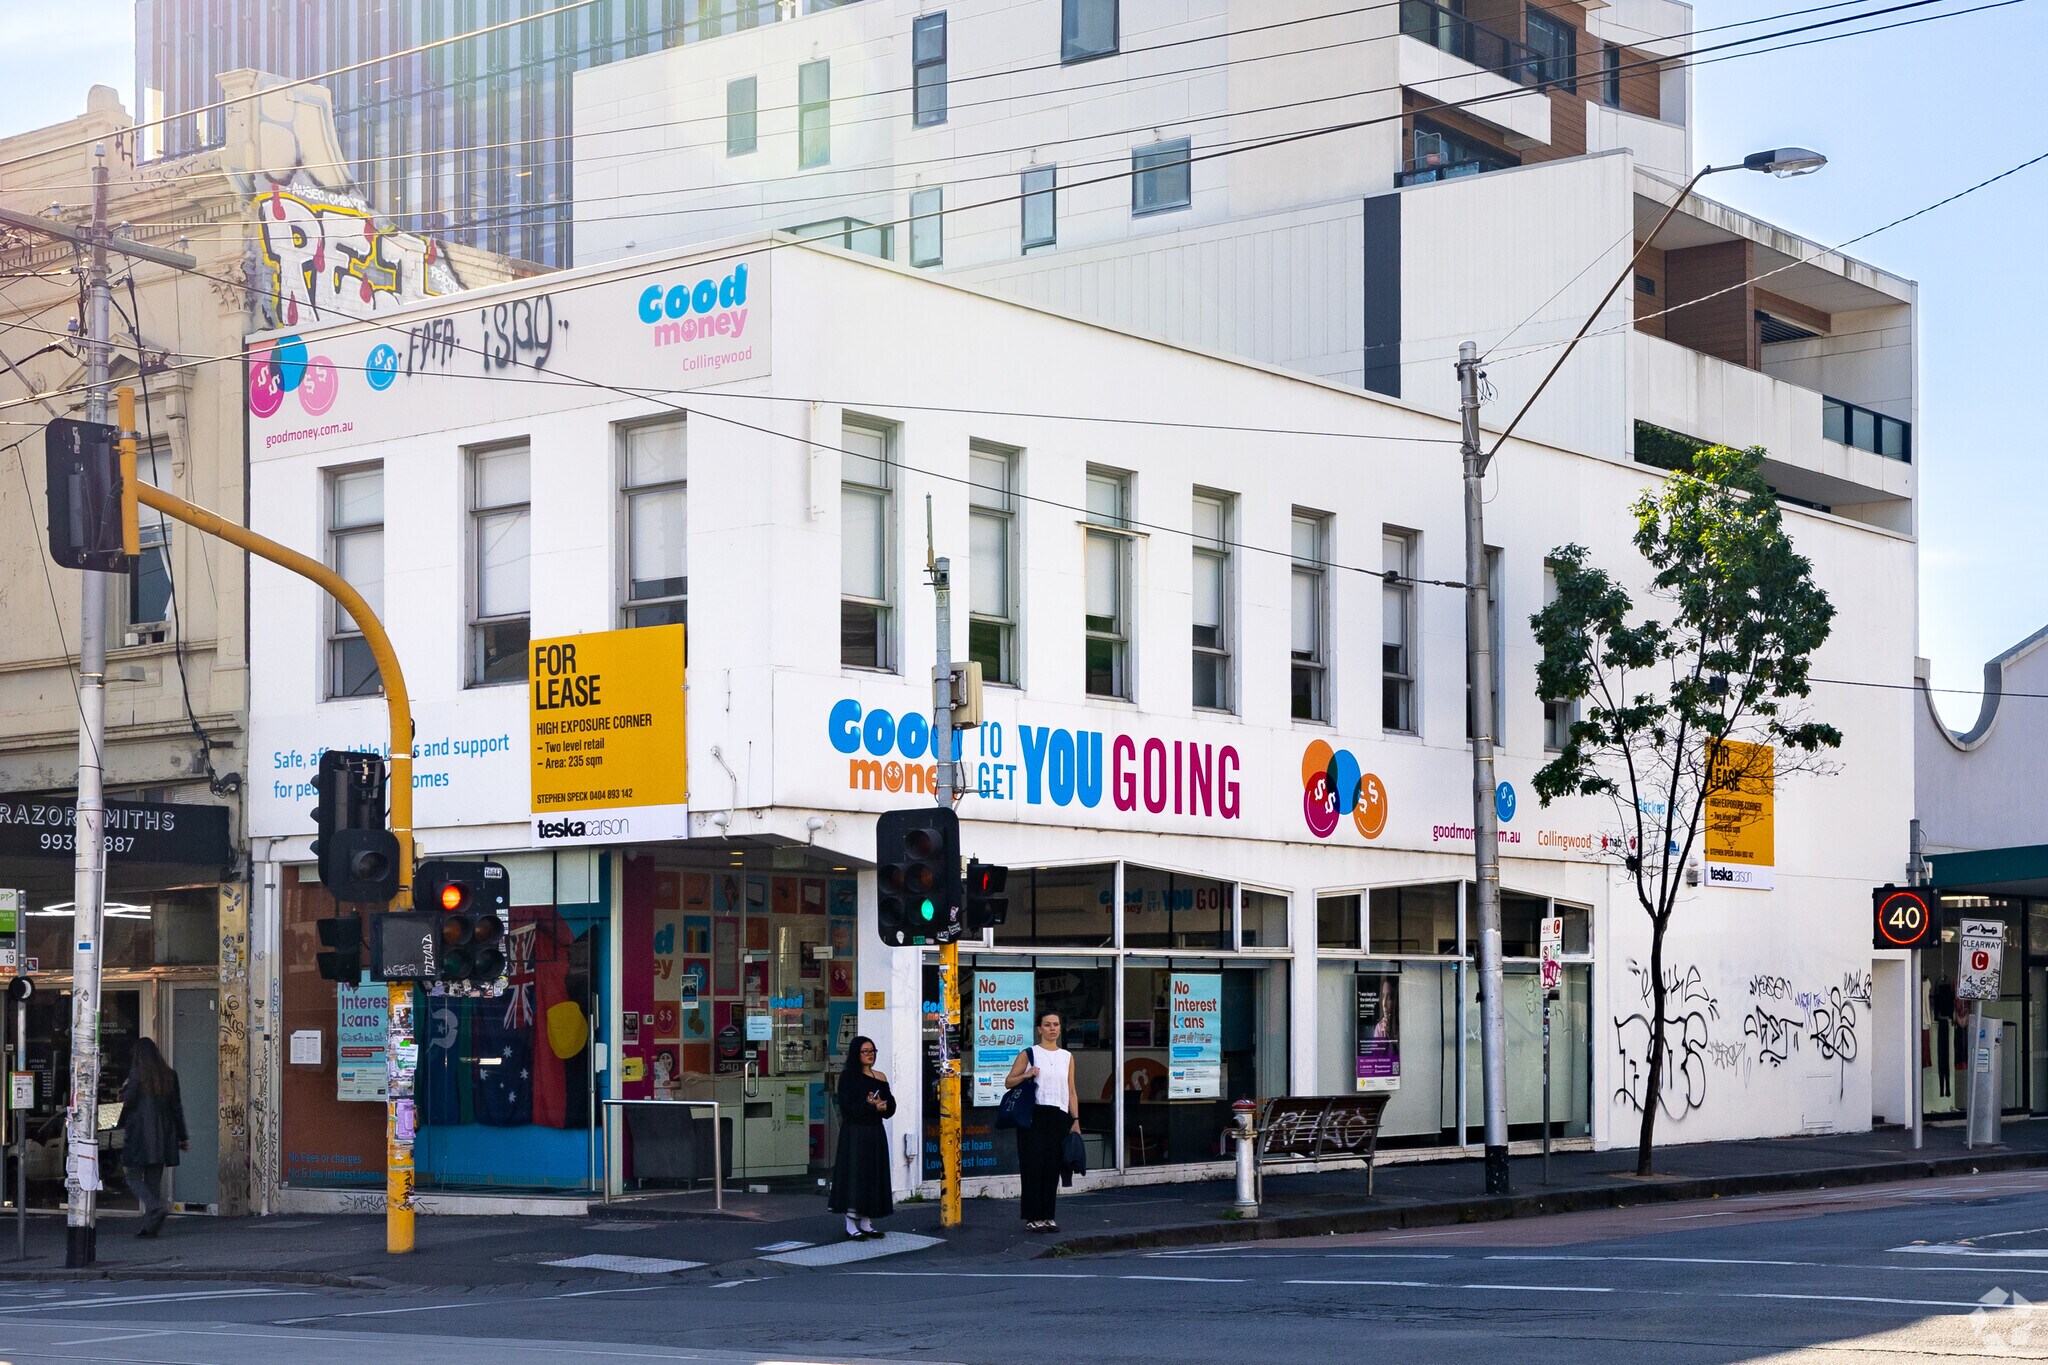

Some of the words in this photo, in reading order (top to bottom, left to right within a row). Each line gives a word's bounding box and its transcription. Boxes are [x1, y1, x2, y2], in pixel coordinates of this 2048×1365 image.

[638, 262, 748, 325] Good
[654, 308, 748, 347] money
[682, 345, 752, 372] Collingwood
[265, 420, 354, 449] goodmoney.com.au
[535, 643, 576, 677] FOR
[536, 674, 601, 710] LEASE
[536, 720, 559, 736] HIGH
[561, 716, 611, 734] EXPOSURE
[613, 713, 653, 731] CORNER
[545, 740, 562, 754] Two
[562, 739, 582, 752] level
[584, 737, 605, 752] retail
[980, 721, 1002, 758] TO
[273, 746, 306, 770] Safe,
[424, 737, 449, 757] and
[453, 734, 510, 756] support
[545, 757, 567, 770] Area:
[568, 756, 584, 768] 235
[586, 755, 603, 769] sqm
[850, 758, 958, 803] mone
[978, 762, 1017, 801] GET
[1018, 724, 1103, 808] YOU
[1112, 734, 1240, 820] GOING
[273, 780, 292, 799] for
[537, 792, 566, 804] STEPHEN
[567, 791, 588, 803] SPECK
[590, 790, 606, 801] 0404
[607, 789, 620, 800] 893
[622, 788, 633, 799] 142
[0, 802, 176, 832] RAZORMITHS
[538, 816, 630, 839] teskacarson
[40, 833, 77, 851] 993
[1538, 830, 1592, 851] Collingwood
[1162, 888, 1193, 912] YOU
[1888, 906, 1921, 929] 40
[1962, 939, 2001, 950] CLEARWAY
[979, 978, 996, 994] No
[1174, 980, 1190, 995] No
[342, 996, 388, 1010] Interes
[978, 998, 1029, 1013] Interest
[1174, 998, 1217, 1012] Interest
[342, 1013, 380, 1028] Loans
[979, 1016, 1015, 1031] Loans
[1174, 1014, 1205, 1028] Loans
[926, 1142, 938, 1153] No
[972, 1140, 992, 1151] loans
[976, 1156, 998, 1167] loans
